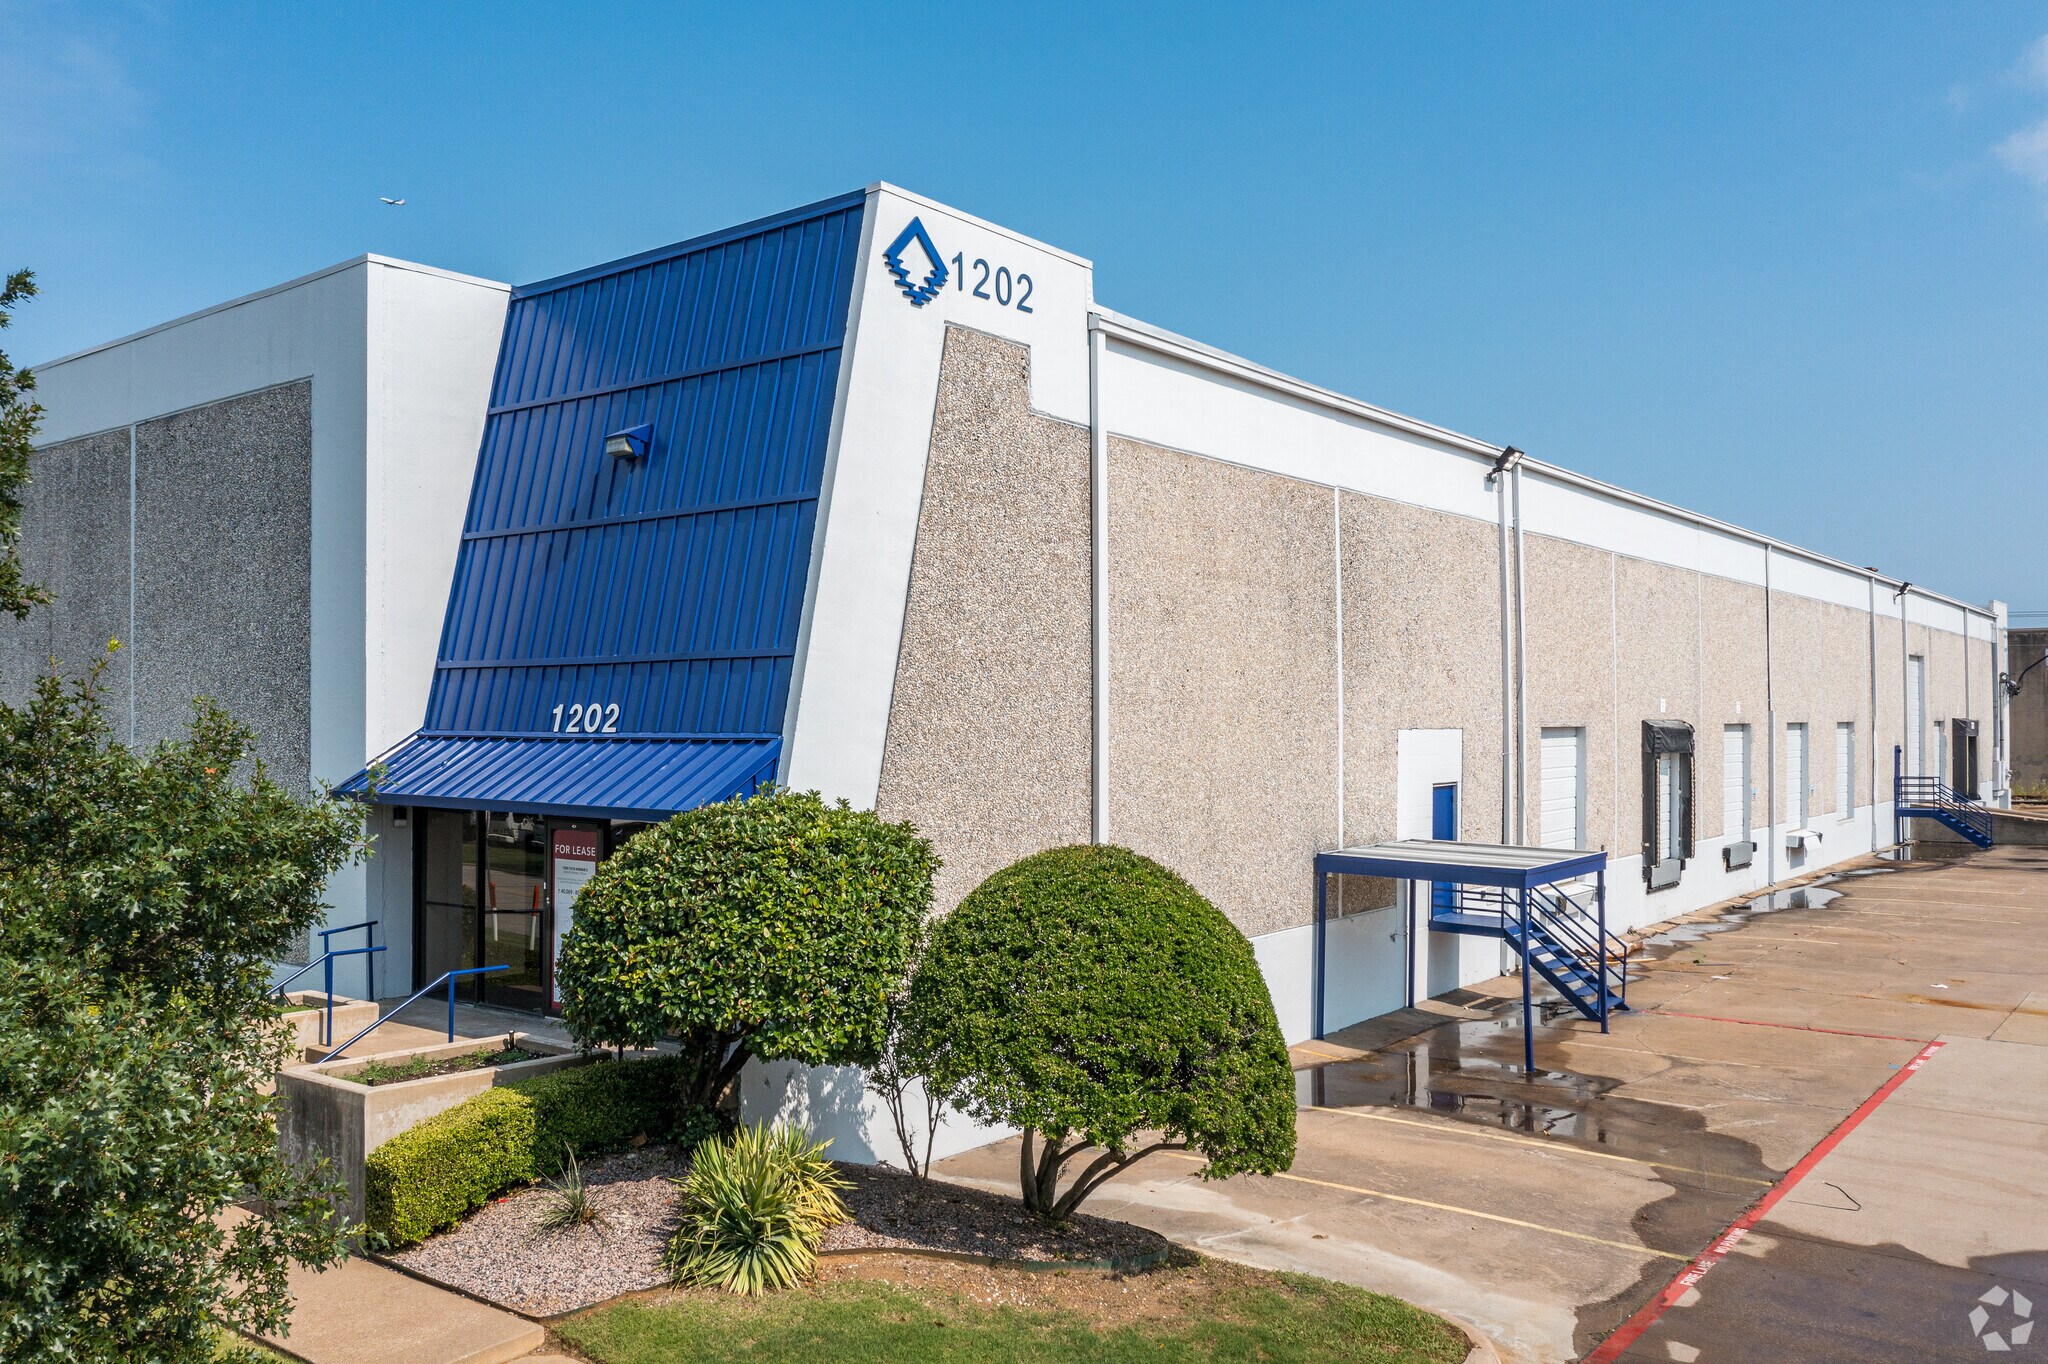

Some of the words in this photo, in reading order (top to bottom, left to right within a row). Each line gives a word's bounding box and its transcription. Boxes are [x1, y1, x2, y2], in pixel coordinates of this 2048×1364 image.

[951, 251, 1034, 314] 1202
[552, 703, 620, 733] 1202
[555, 844, 571, 854] FOR
[572, 845, 595, 856] LEASE
[1679, 1272, 1703, 1286] FIRE
